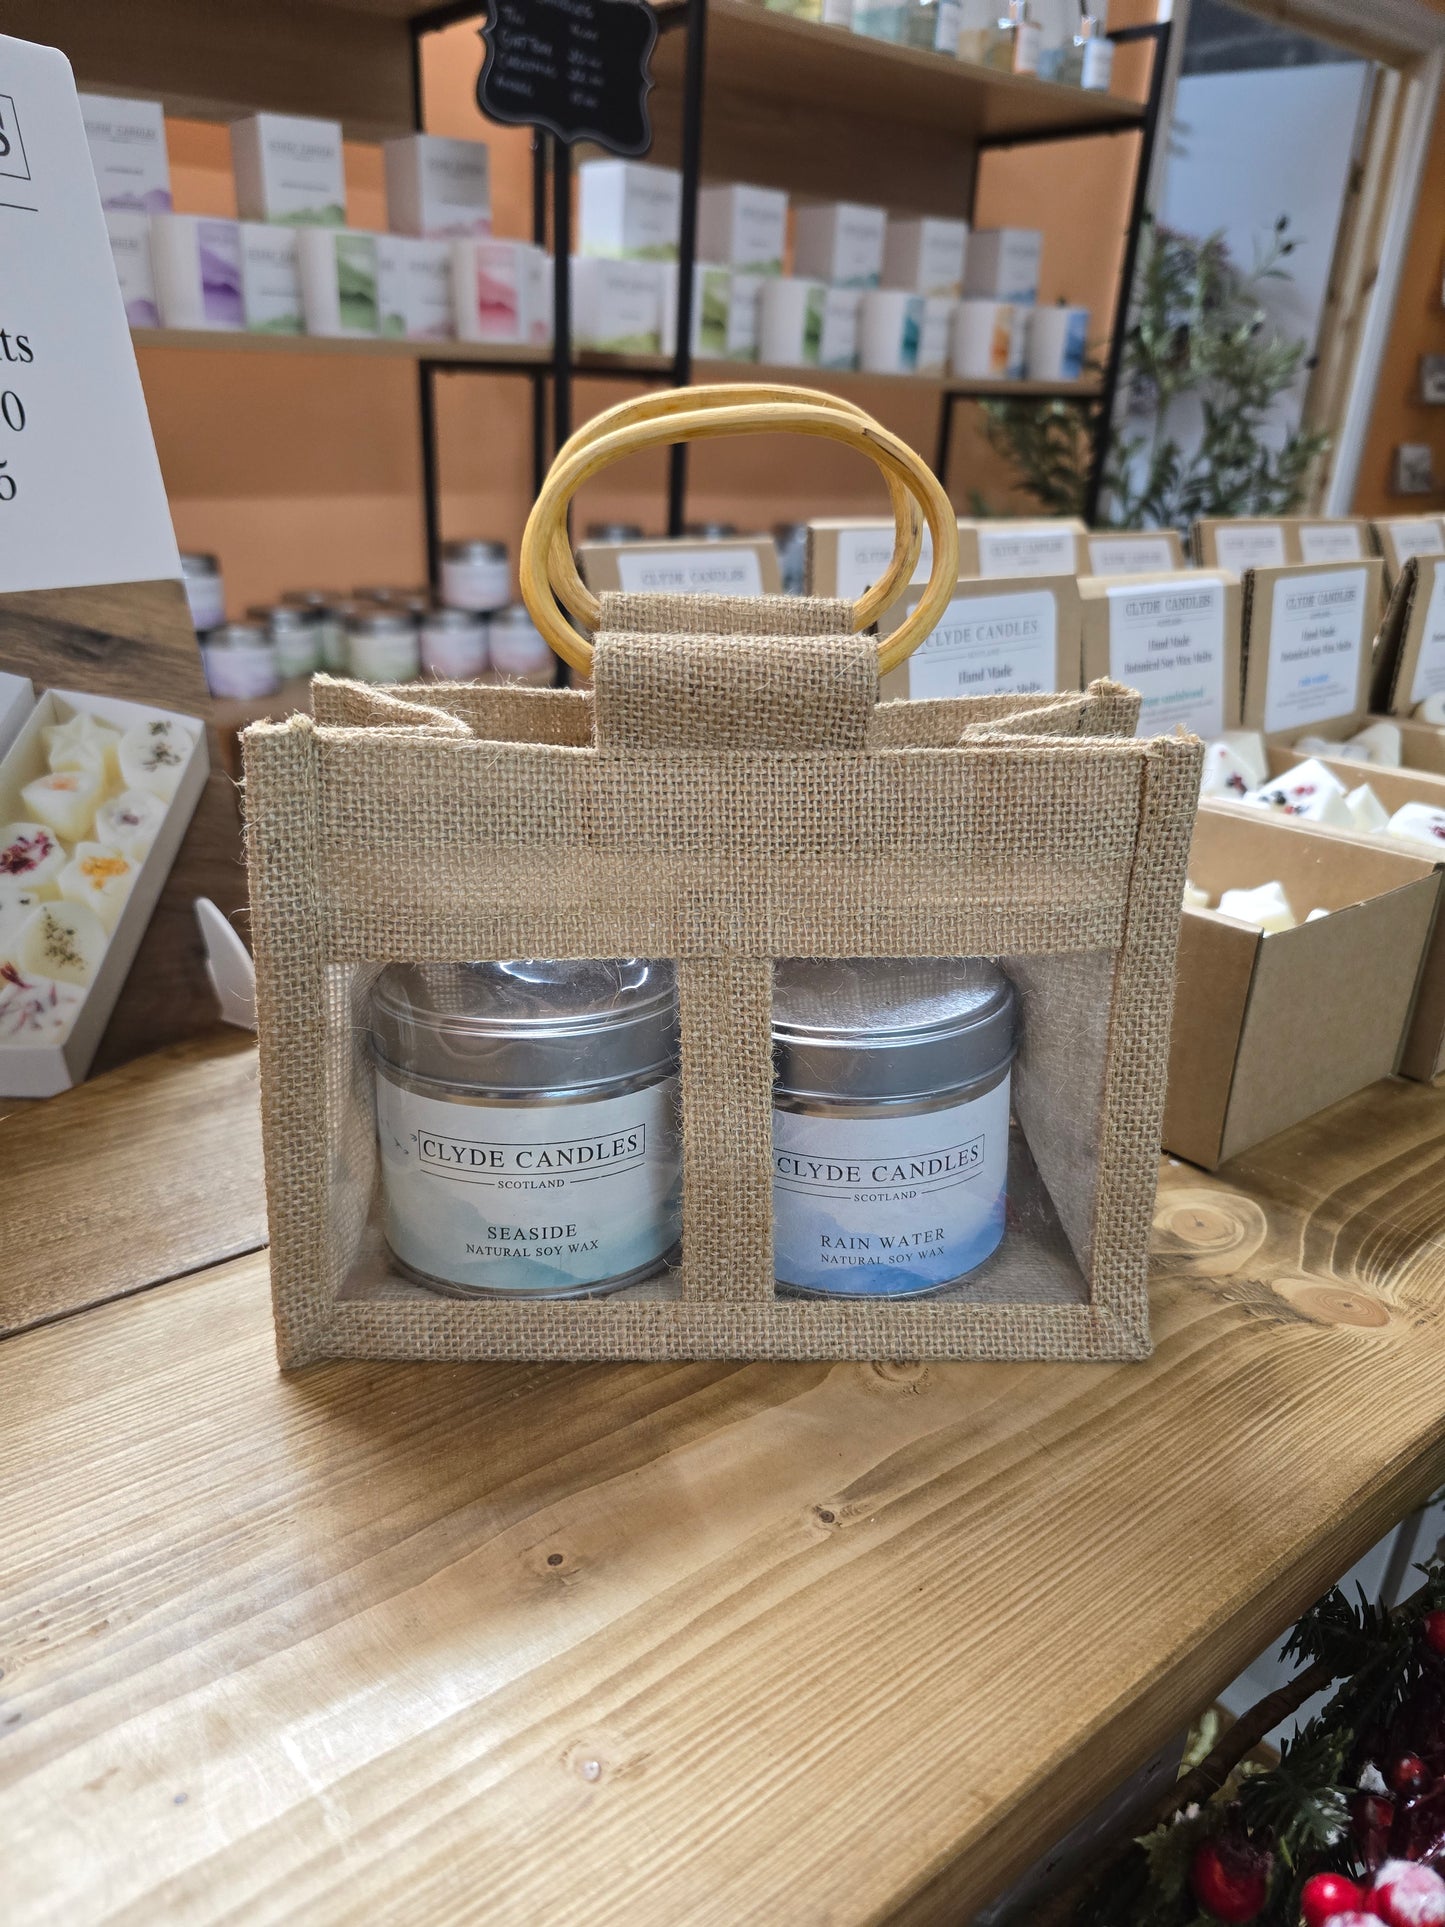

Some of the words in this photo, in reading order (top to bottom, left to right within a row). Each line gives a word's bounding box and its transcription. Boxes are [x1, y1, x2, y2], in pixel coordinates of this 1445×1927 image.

[1125, 600, 1161, 617] CLYDE
[1165, 595, 1211, 611] CANDLES
[926, 628, 971, 648] CLYDE
[976, 620, 1038, 641] CANDLES
[423, 1138, 505, 1168] CLYDE
[515, 1133, 639, 1169] CANDLES
[777, 1156, 861, 1183] CLYDE
[871, 1144, 980, 1183] CANDLES
[497, 1178, 566, 1190] SCOTLAND
[853, 1189, 918, 1203] SCOTLAND
[487, 1223, 578, 1241] SEASIDE
[820, 1234, 871, 1250] RAIN
[878, 1228, 946, 1248] WATER
[466, 1243, 531, 1258] NATURAL
[535, 1245, 563, 1258] SOY
[568, 1239, 600, 1253] WAX
[821, 1253, 883, 1266] NATURAL
[888, 1253, 914, 1265] SOY
[917, 1245, 946, 1260] WAX
